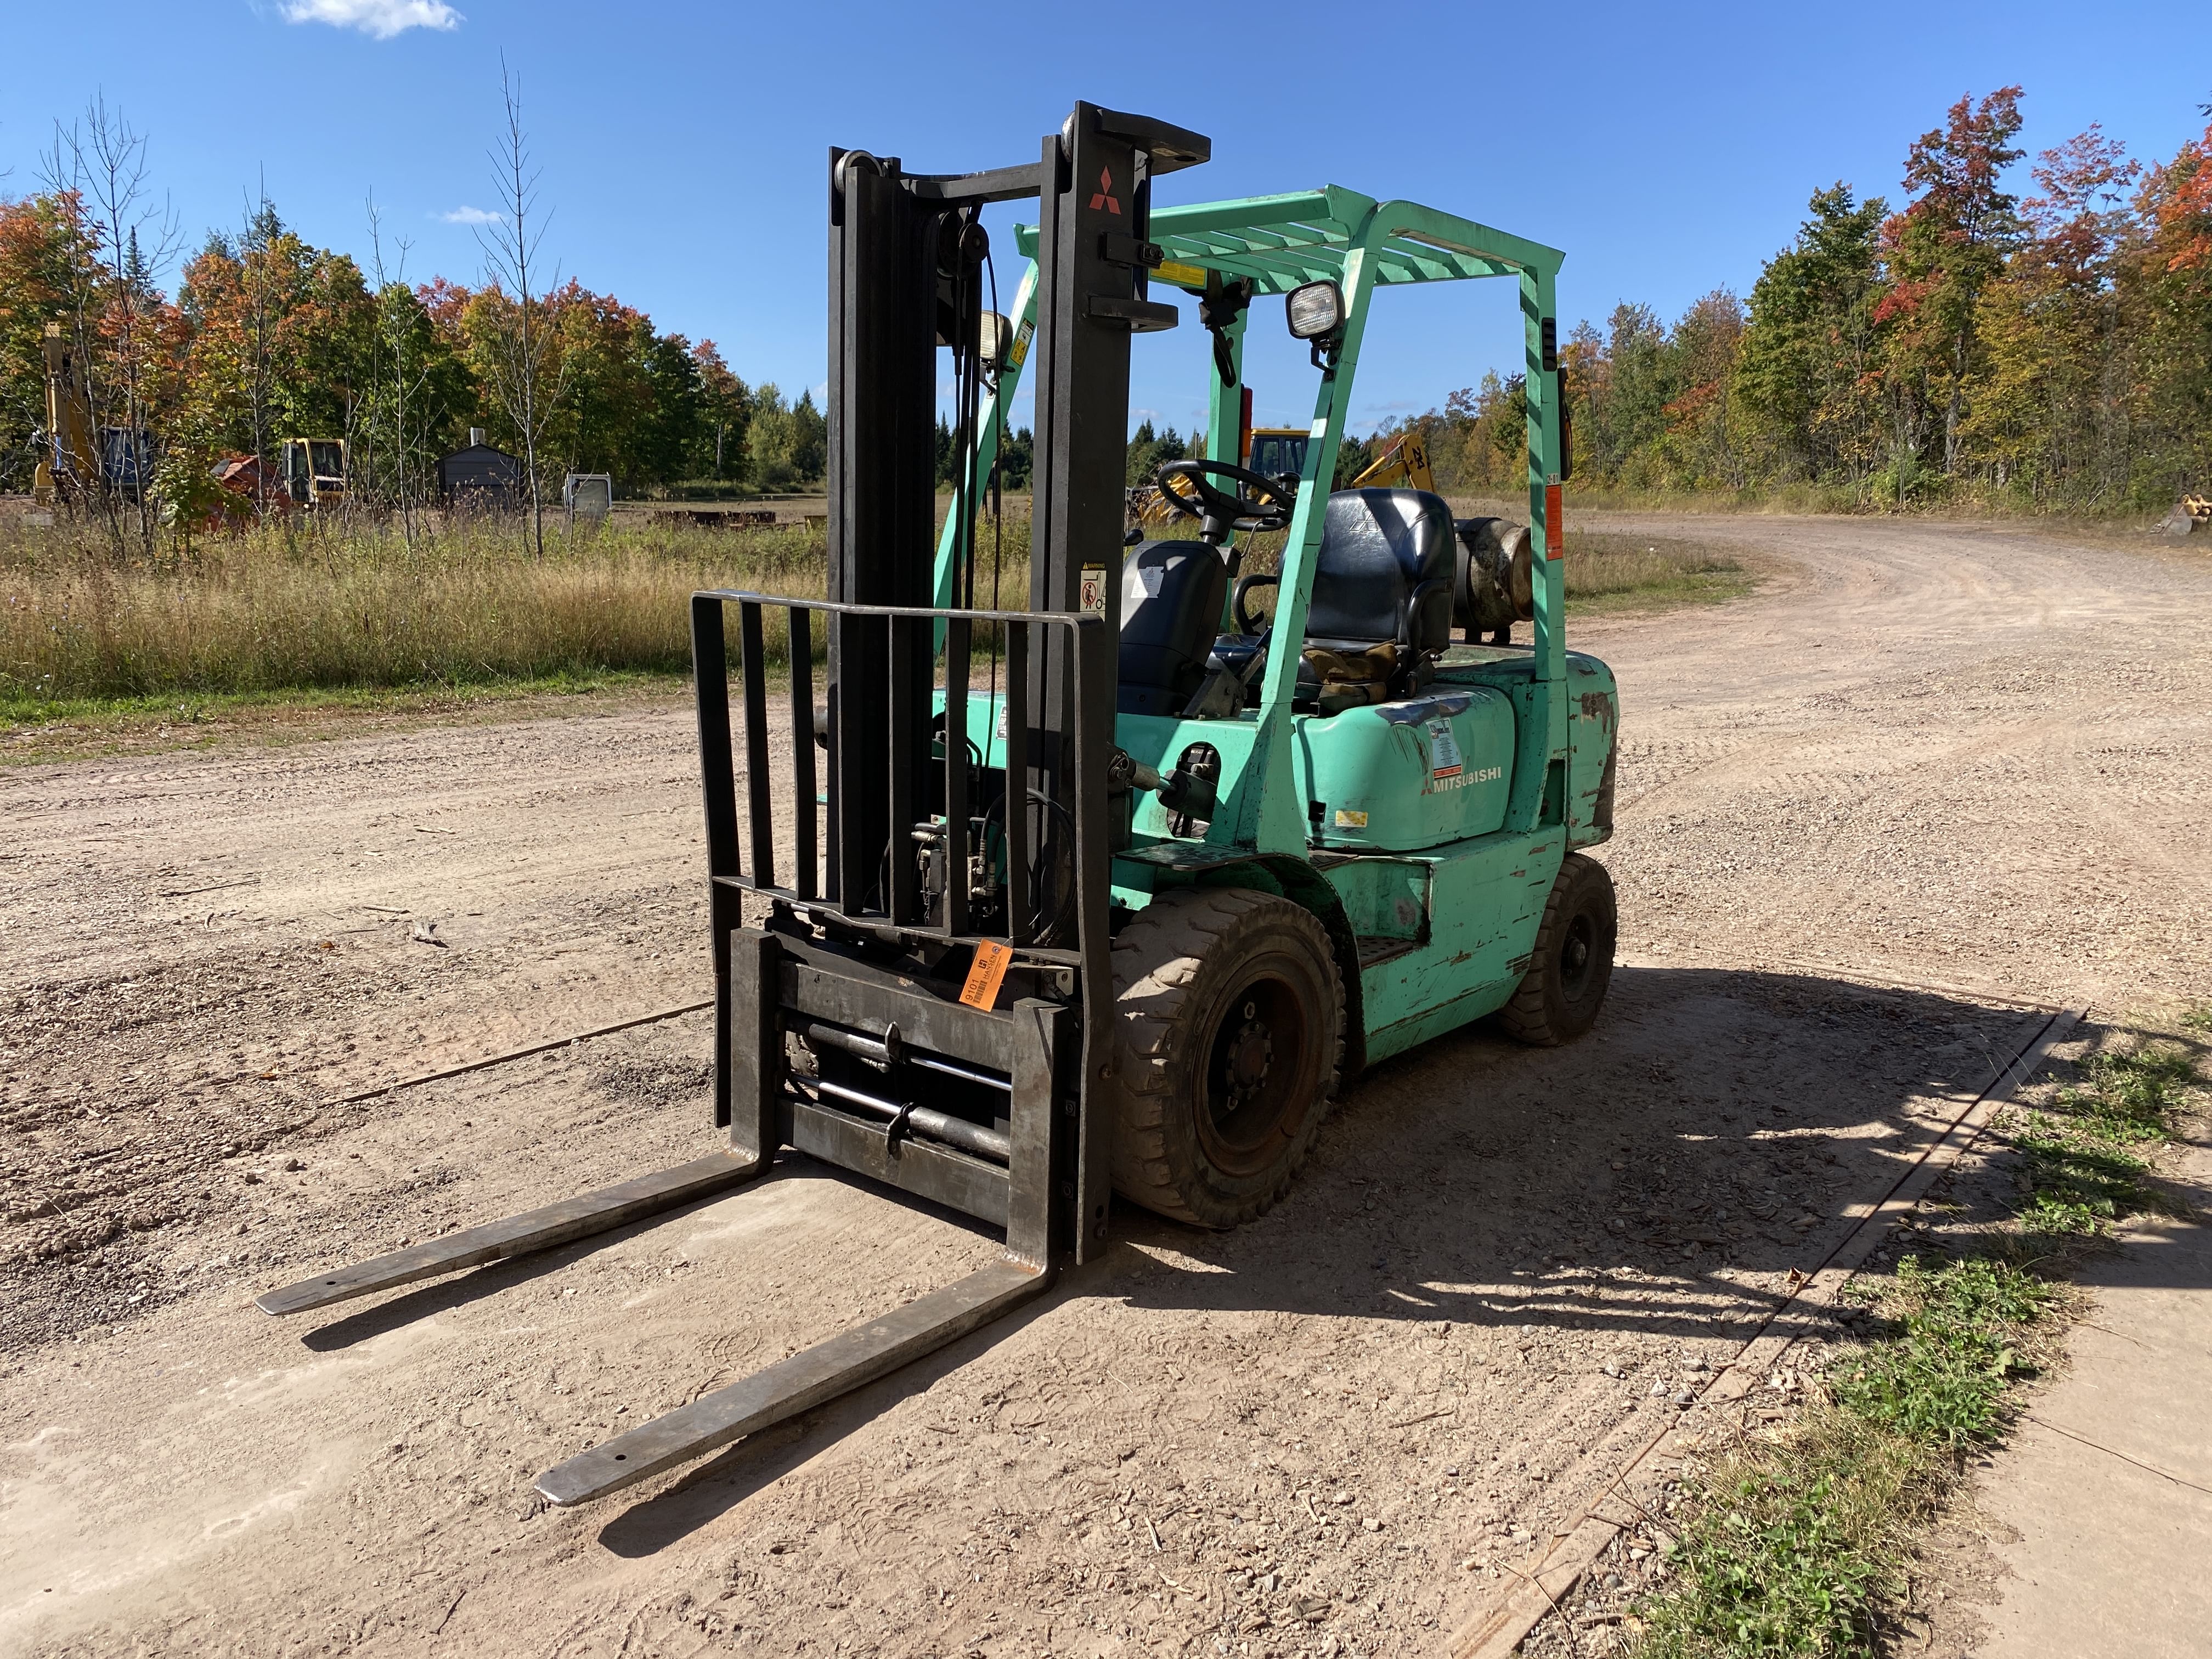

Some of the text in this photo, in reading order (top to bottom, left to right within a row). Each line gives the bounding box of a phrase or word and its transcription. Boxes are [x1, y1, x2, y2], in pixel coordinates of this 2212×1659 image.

[1434, 766, 1501, 793] MITSUBISHI
[983, 955, 996, 979] HANSEN
[966, 979, 979, 1001] 9101
